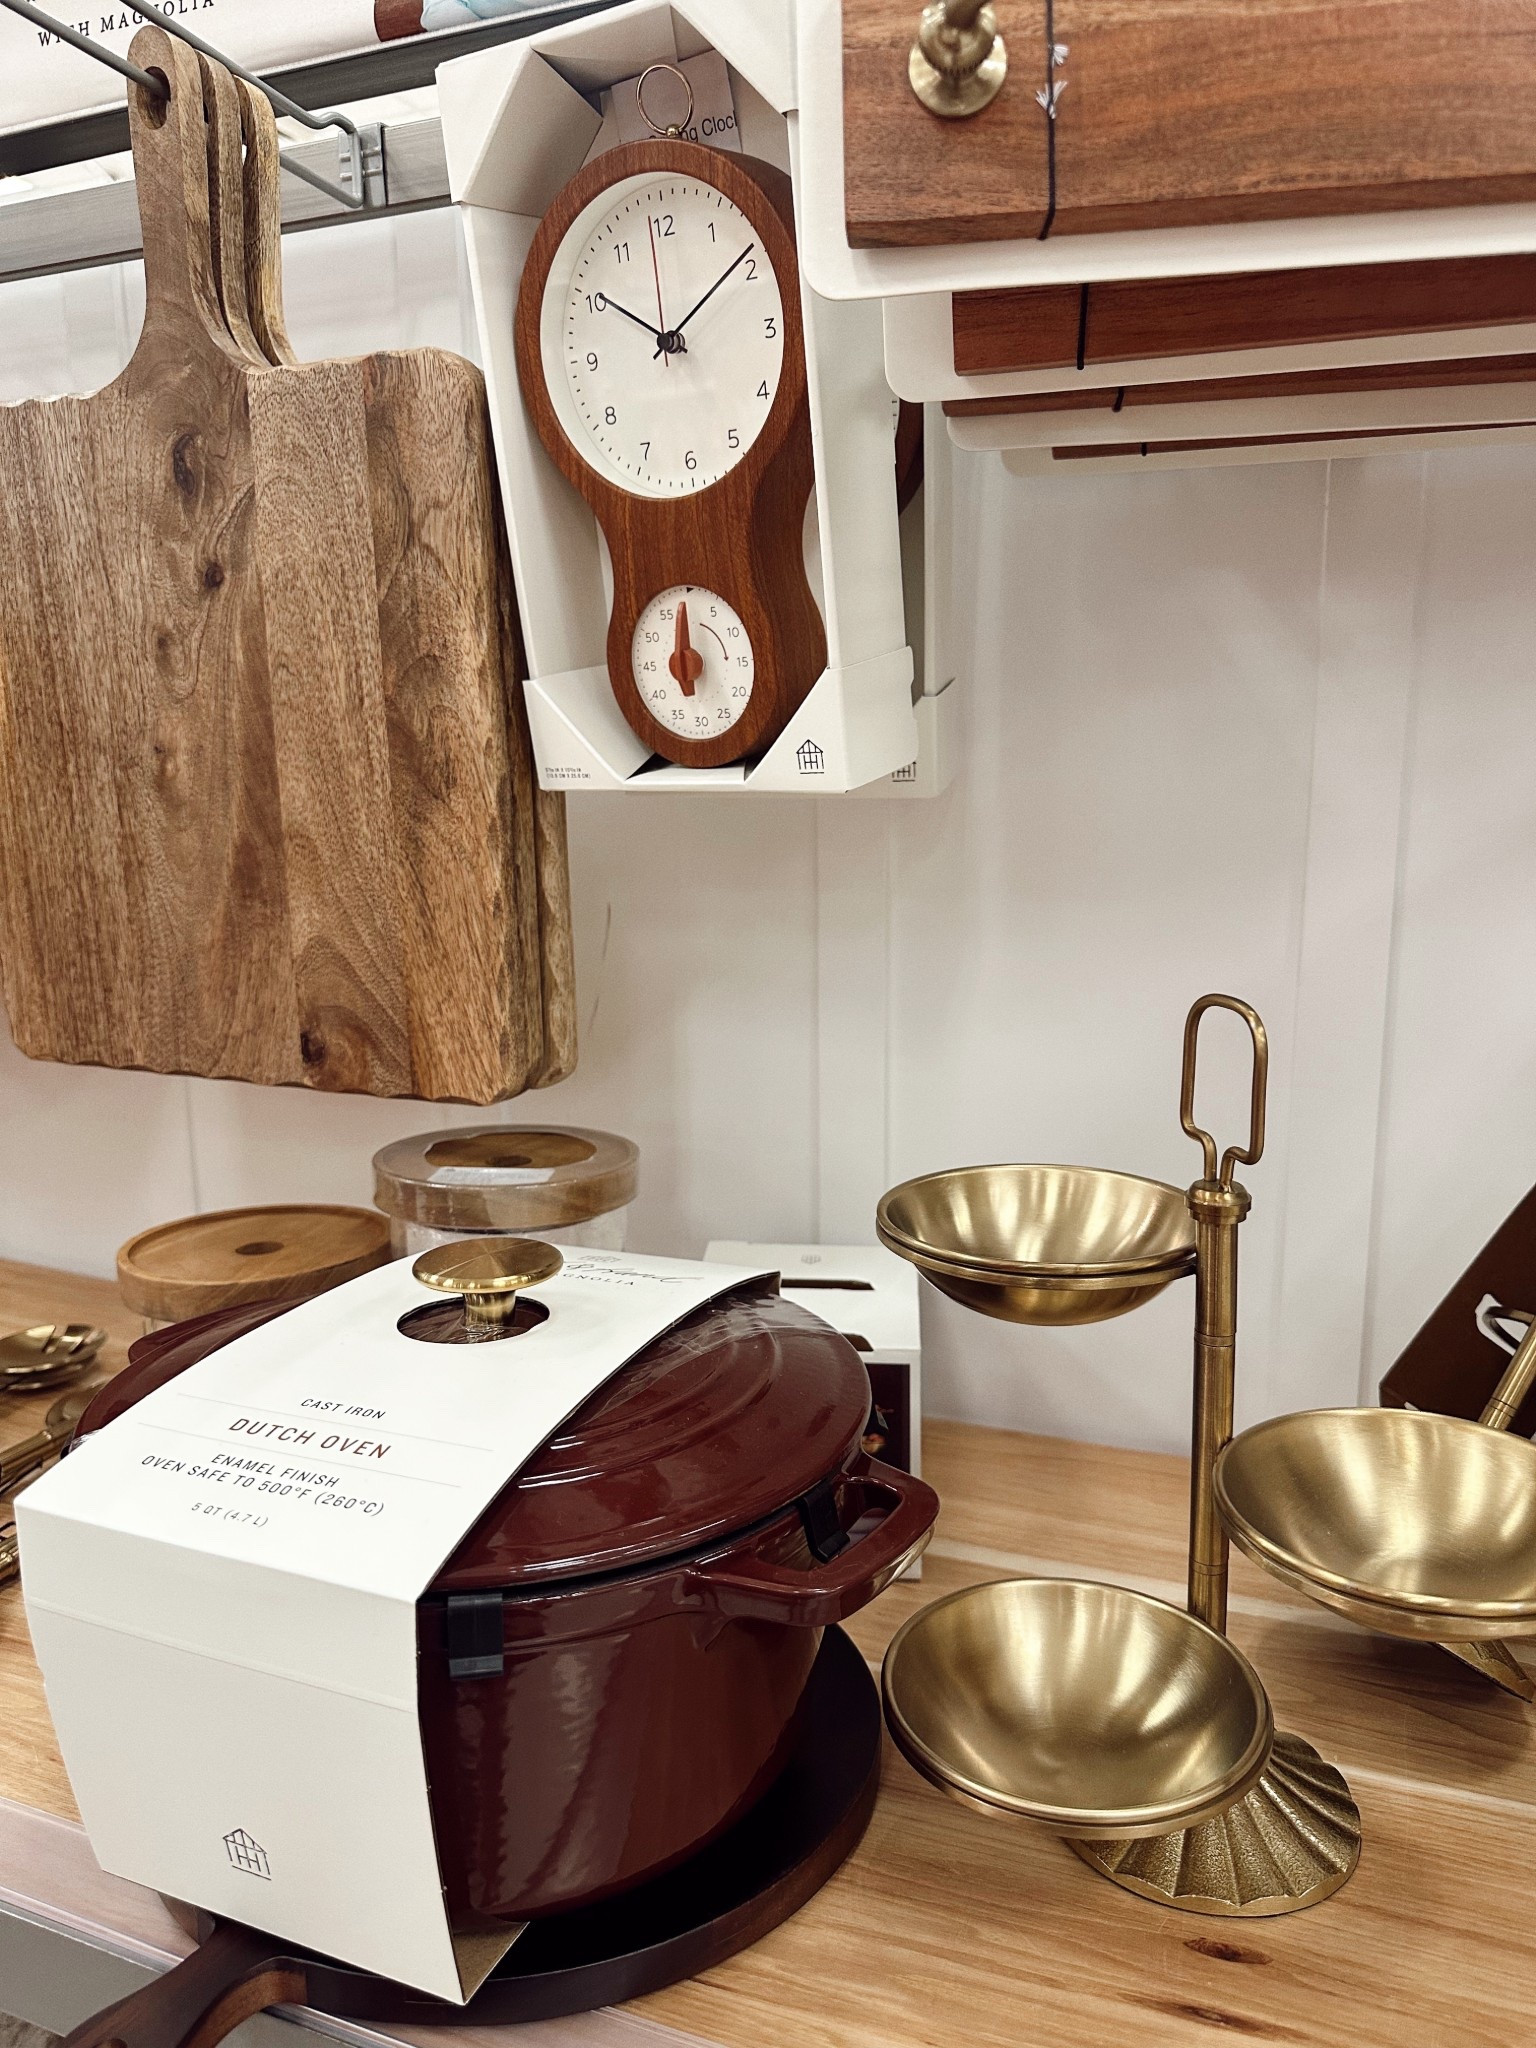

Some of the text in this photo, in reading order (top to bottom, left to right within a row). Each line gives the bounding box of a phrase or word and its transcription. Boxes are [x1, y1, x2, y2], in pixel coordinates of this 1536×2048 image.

[38, 0, 215, 47] WH MAGOLIA
[653, 214, 676, 239] 12
[708, 222, 717, 242] 1
[613, 242, 631, 264] 11
[745, 259, 759, 282] 2
[585, 292, 607, 314] 10
[764, 317, 778, 340] 3
[586, 352, 599, 372] 9
[756, 380, 770, 401] 4
[604, 406, 618, 426] 8
[728, 428, 740, 449] 5
[640, 442, 651, 461] 7
[684, 450, 697, 470] 6
[659, 609, 674, 621] 55
[710, 606, 717, 618] 5
[645, 632, 660, 643] 50
[727, 627, 740, 638] 10
[643, 661, 657, 672] 45
[736, 656, 749, 668] 15
[652, 689, 667, 700] 40
[731, 686, 747, 698] 20
[671, 709, 685, 720] 35
[695, 716, 709, 727] 30
[717, 708, 731, 719] 25
[562, 1273, 634, 1286] GNOLIA
[301, 1398, 386, 1419] CAST IRON
[228, 1418, 392, 1459] DUTCH OVEN
[211, 1453, 340, 1488] ENAMEL FINISH
[141, 1454, 385, 1516] OVEN SAFE TO 500°F (260°C)
[191, 1502, 201, 1512] 5
[203, 1504, 221, 1516] QT
[223, 1509, 252, 1523] (4.7
